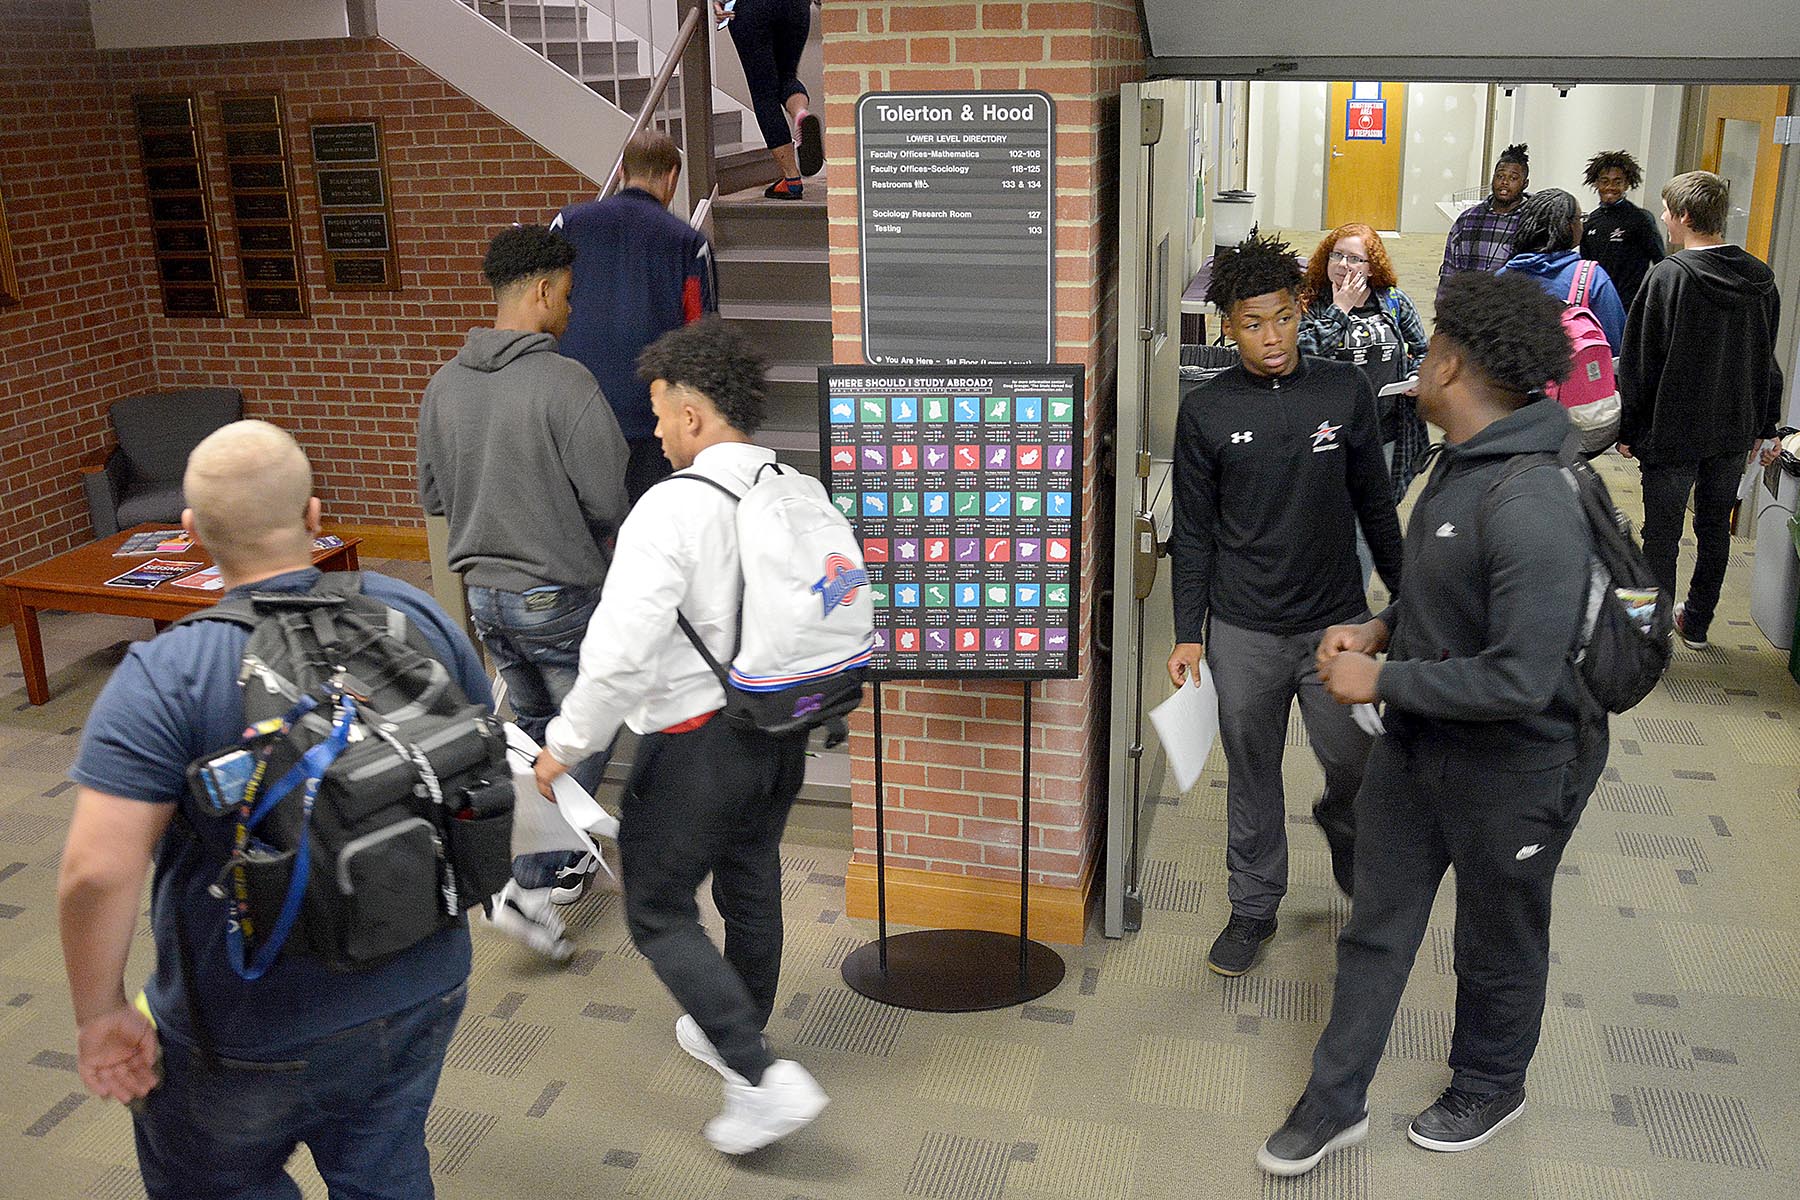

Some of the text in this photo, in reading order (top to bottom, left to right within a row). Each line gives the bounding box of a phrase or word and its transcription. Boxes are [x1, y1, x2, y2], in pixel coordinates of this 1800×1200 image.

[876, 103, 1034, 122] Tolerton & Hood
[906, 135, 1008, 143] LOWER LEVEL DIRECTORY
[870, 150, 980, 159] Faculty Offices-Mathematics
[1008, 150, 1041, 158] 102-108
[870, 165, 970, 174] Faculty Offices-Sociology
[1011, 165, 1041, 173] 118-125
[871, 180, 913, 189] Restrooms
[1001, 180, 1016, 189] 133
[1028, 180, 1042, 188] 134
[872, 209, 972, 219] Sociology Research Room
[1027, 210, 1042, 219] 127
[874, 224, 902, 233] Testing
[1027, 226, 1043, 235] 103
[885, 355, 899, 364] You
[900, 356, 914, 364] Are
[916, 356, 934, 365] Here
[828, 378, 993, 388] WHERE SHOULD I STUDY ABROAD?
